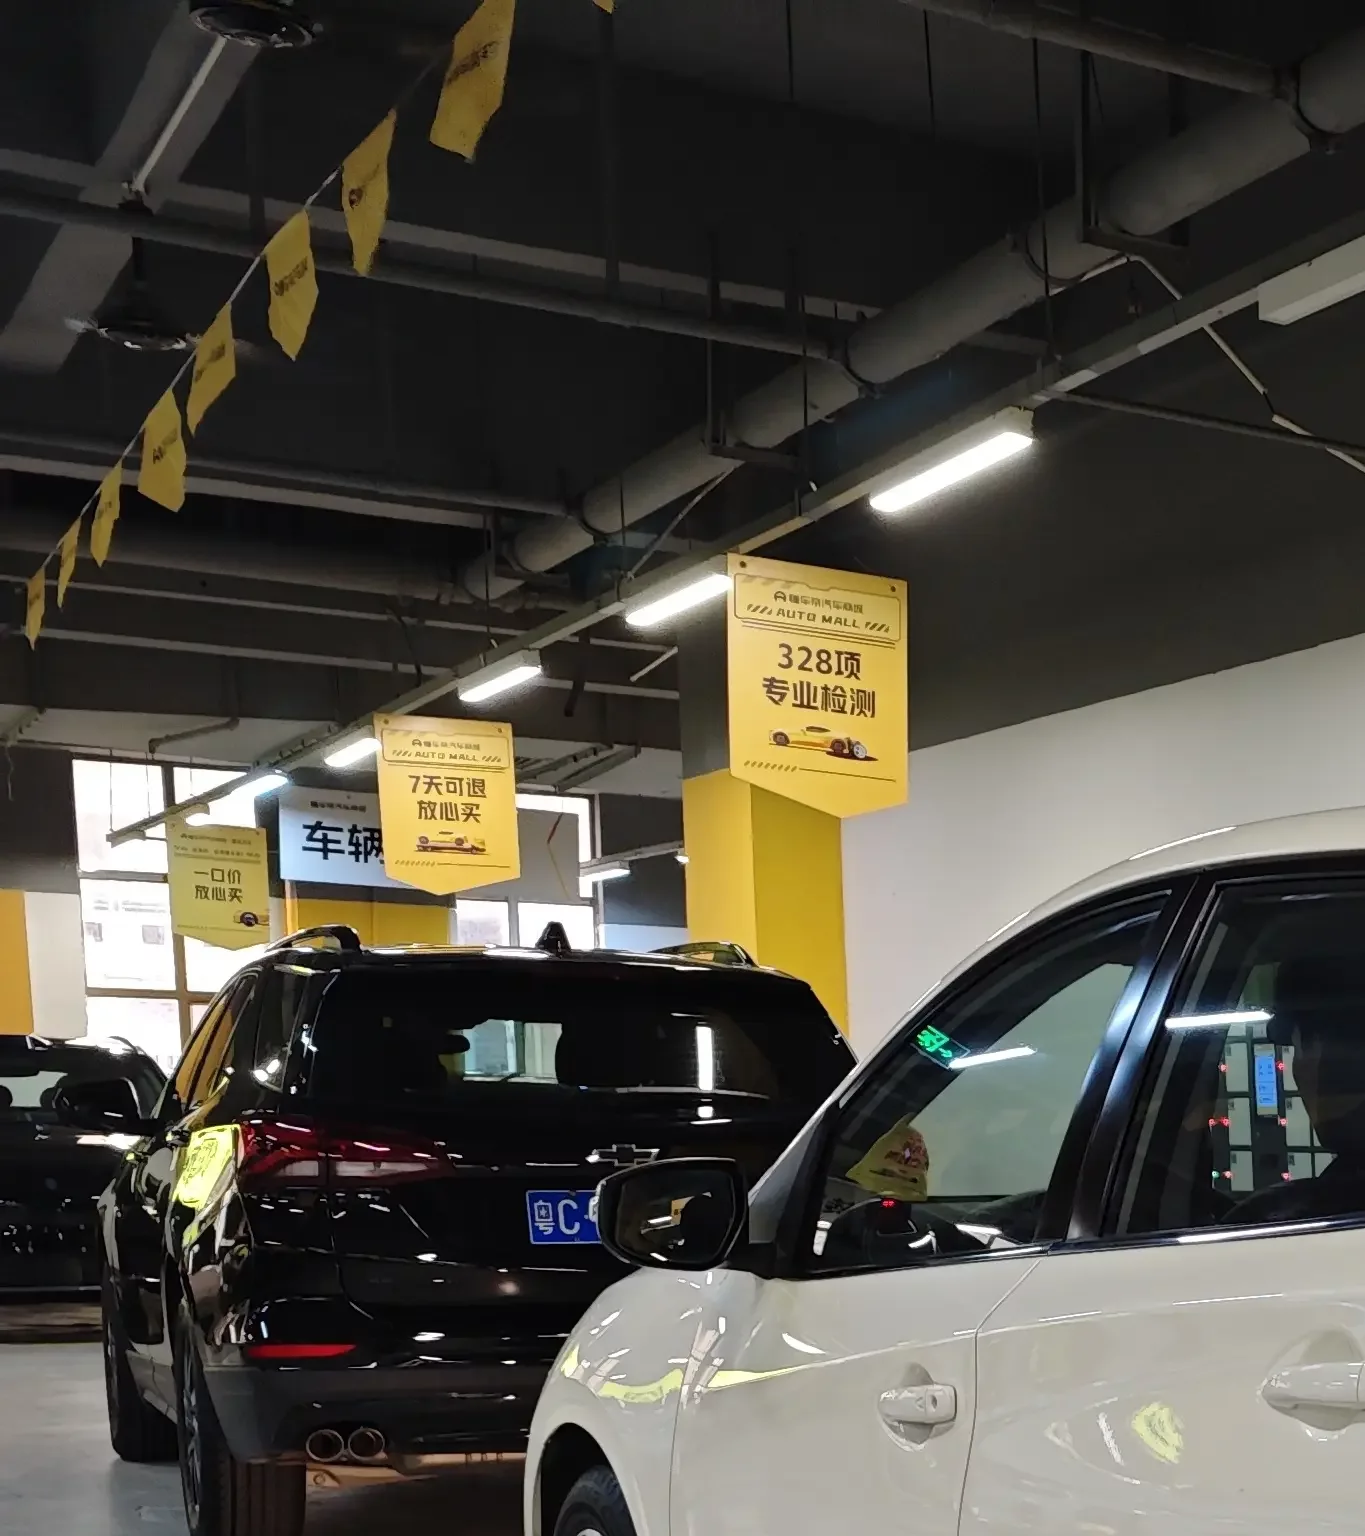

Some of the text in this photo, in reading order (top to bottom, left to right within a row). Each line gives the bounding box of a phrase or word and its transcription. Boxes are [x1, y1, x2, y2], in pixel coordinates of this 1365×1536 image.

[776, 607, 860, 629] AUTO MALL
[777, 642, 862, 681] 328项
[762, 675, 876, 719] 专业检测
[415, 751, 479, 762] AUTO MALL
[408, 774, 487, 799] 7天可退
[417, 799, 482, 824] 放心买
[302, 820, 385, 864] 车辆
[193, 867, 242, 885] 一口价
[194, 884, 243, 904] 放心买
